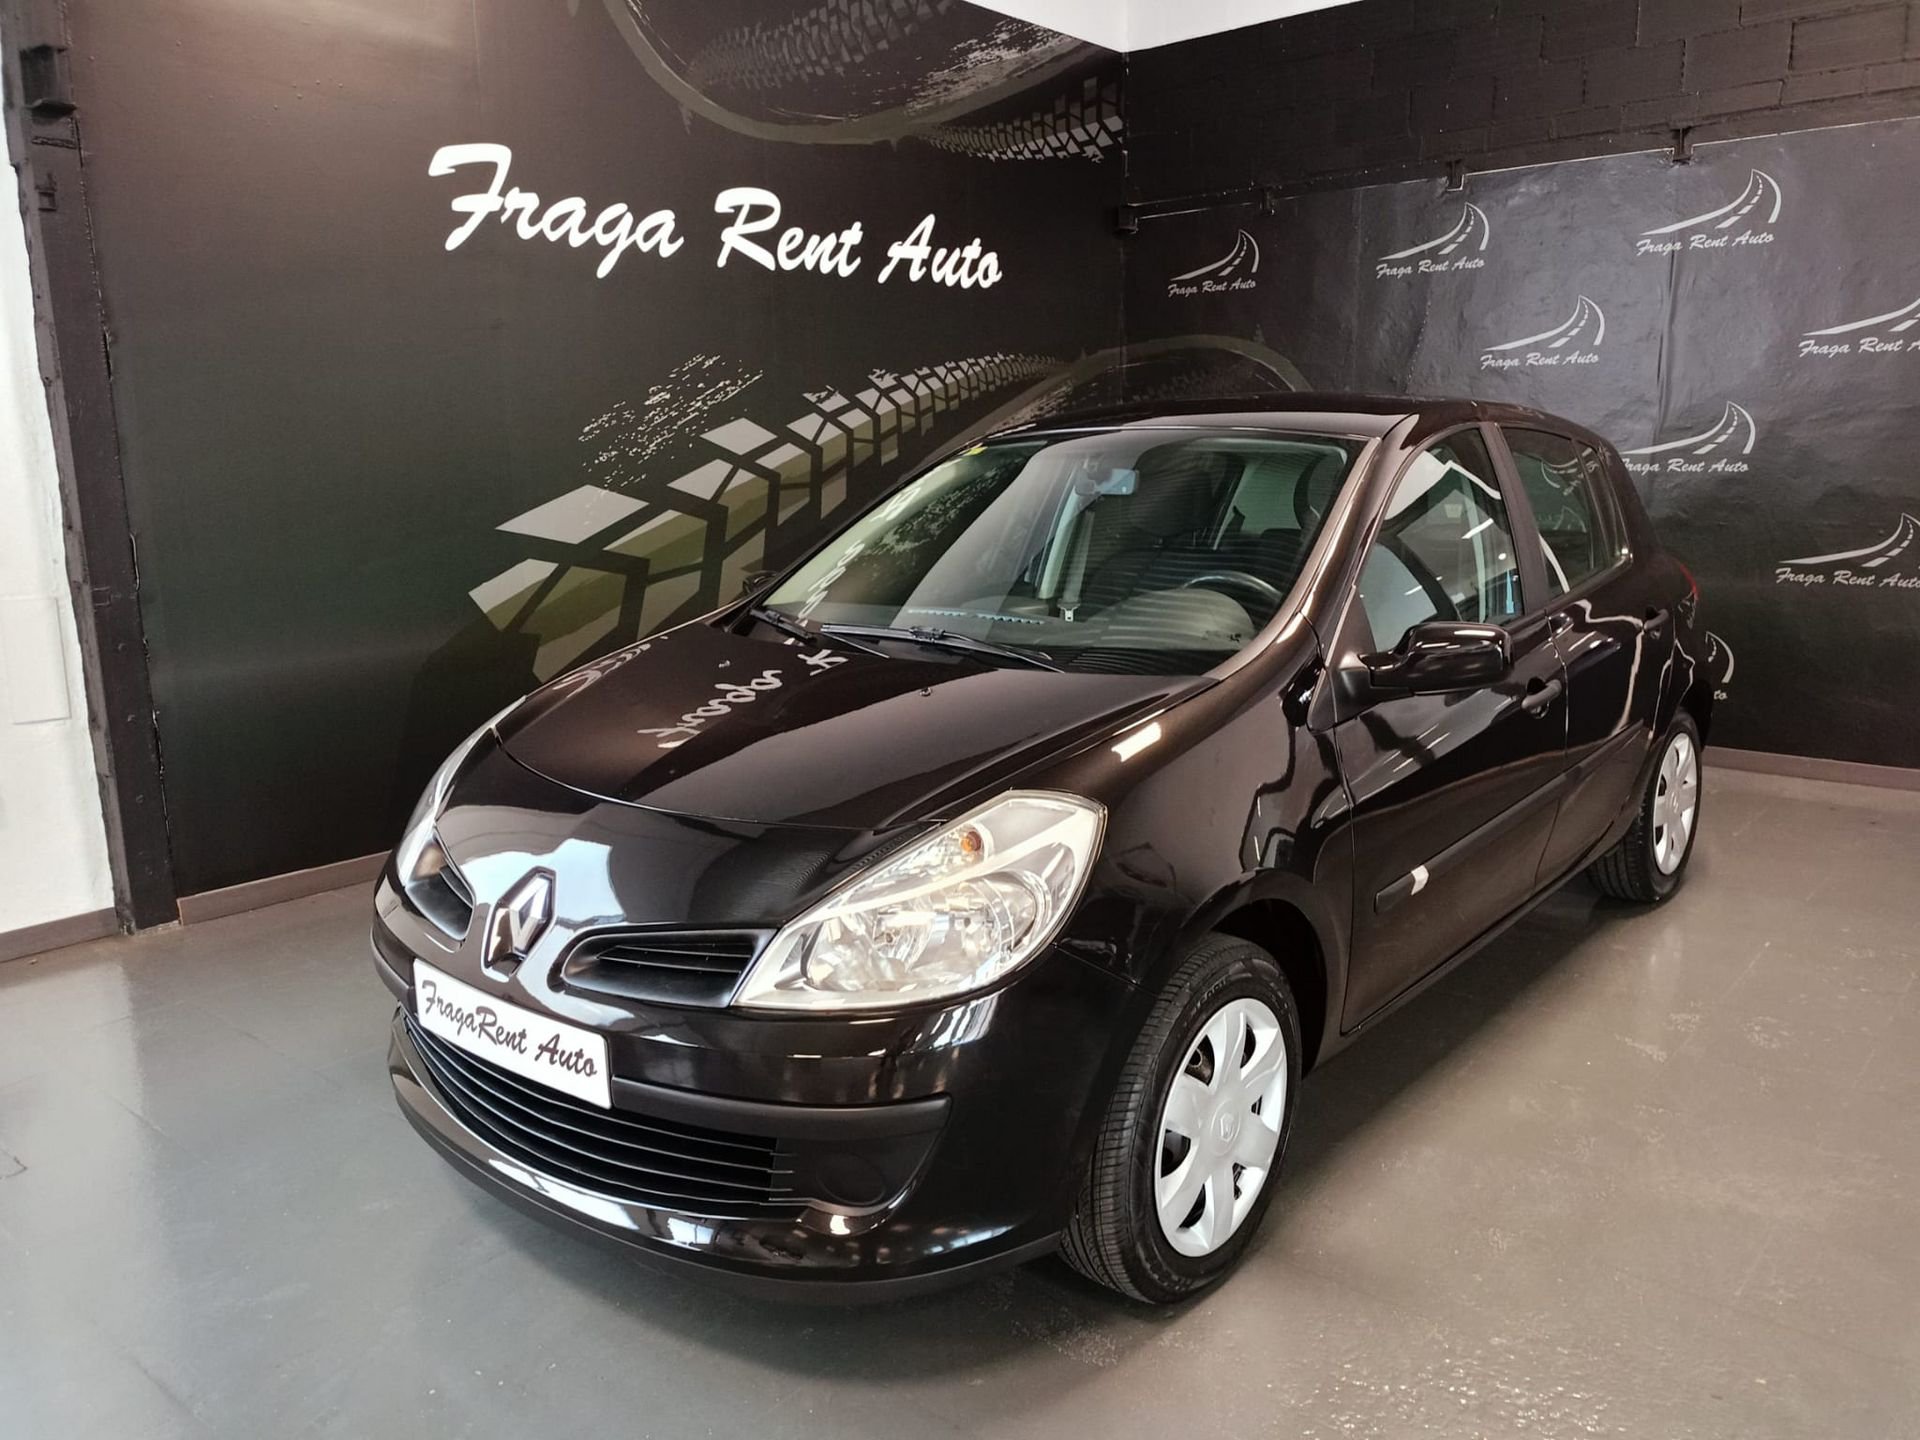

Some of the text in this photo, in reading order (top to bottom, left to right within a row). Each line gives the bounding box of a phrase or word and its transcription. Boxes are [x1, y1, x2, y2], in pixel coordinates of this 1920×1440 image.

[428, 143, 1002, 288] Fraga Rent Auto
[1636, 230, 1775, 256] Fraga Rent Auto
[1375, 256, 1486, 279] Fraga Rent Auto
[1167, 276, 1257, 298] Fraga Rent Auto
[1799, 338, 1852, 359] Fraga
[1858, 337, 1904, 354] Rent
[1480, 350, 1600, 371] Fraga Rent Auto
[1666, 457, 1706, 473] Rent
[1707, 457, 1750, 473] Auto
[1775, 567, 1826, 588] Fraga
[1832, 569, 1876, 587] Rent
[534, 1033, 598, 1078] Auto
